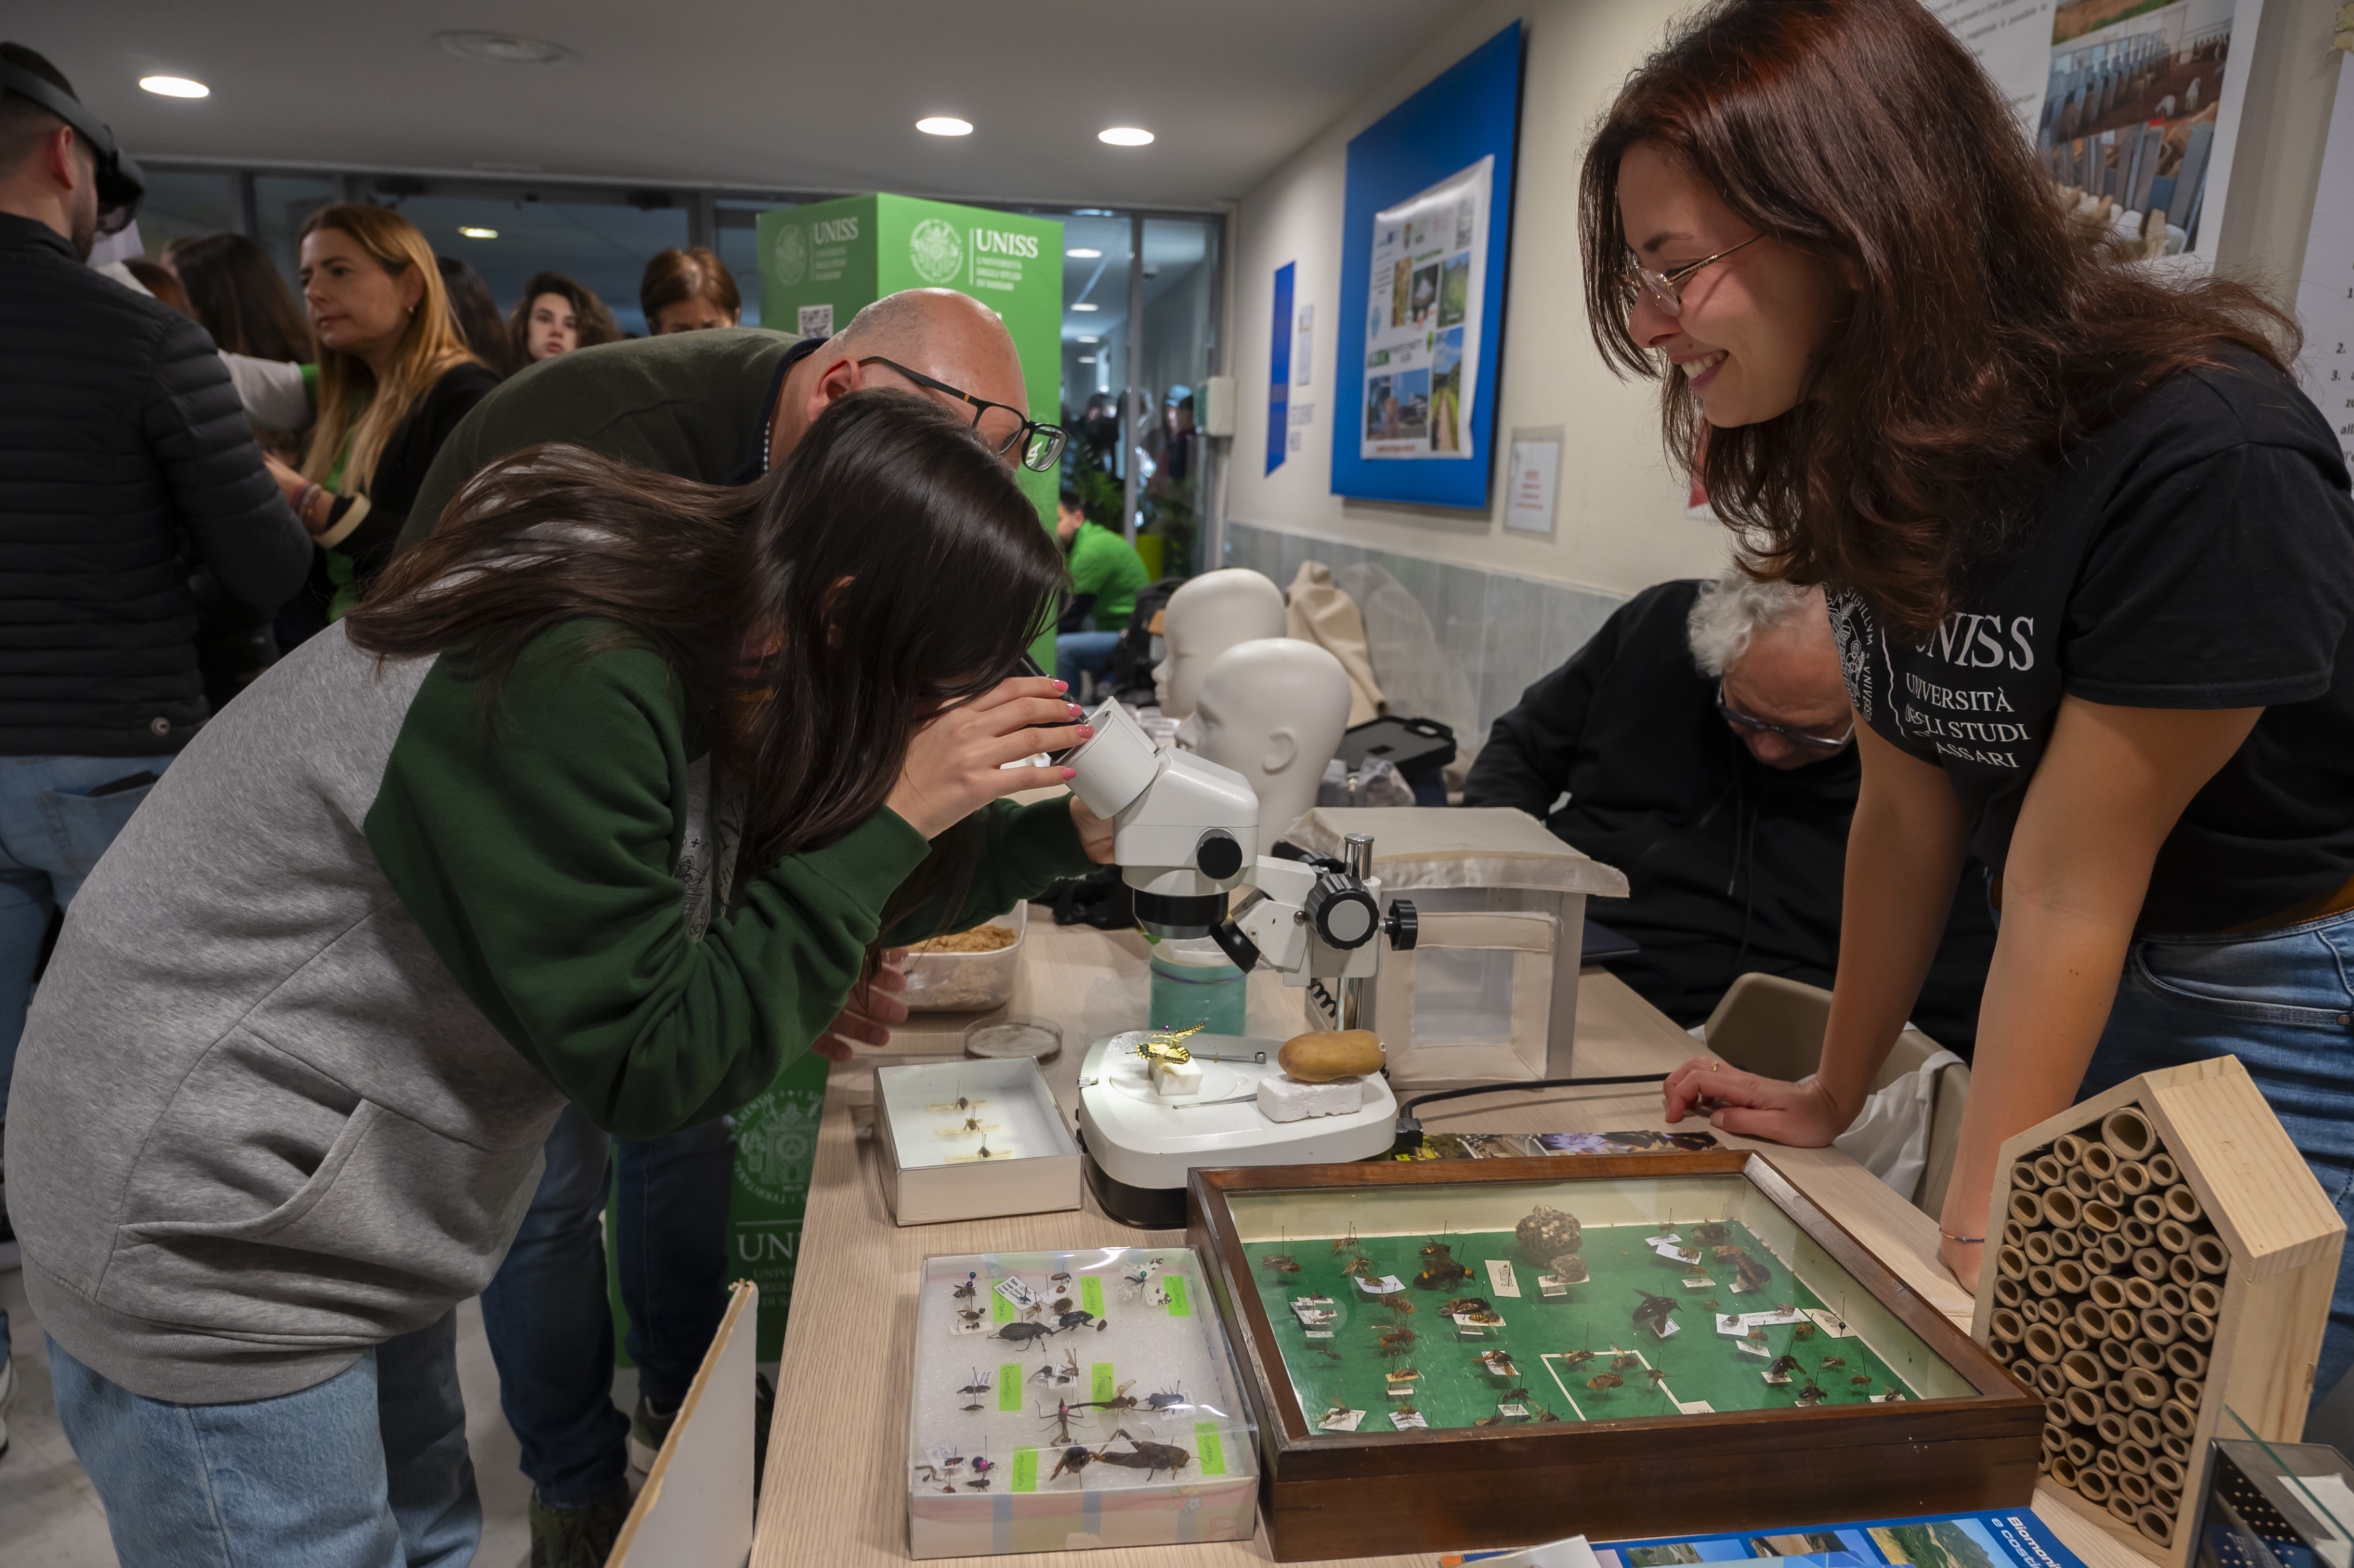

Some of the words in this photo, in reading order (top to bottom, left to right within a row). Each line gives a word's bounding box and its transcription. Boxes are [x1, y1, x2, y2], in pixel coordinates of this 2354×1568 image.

[814, 216, 859, 244] UNISS
[976, 228, 1039, 258] UNISS
[1906, 673, 2015, 713] UNIVERSITÀ
[1948, 721, 2032, 742] STUDI
[1936, 742, 2020, 768] ASSARI
[1991, 1518, 2004, 1527] e
[2000, 1530, 2042, 1568] costi
